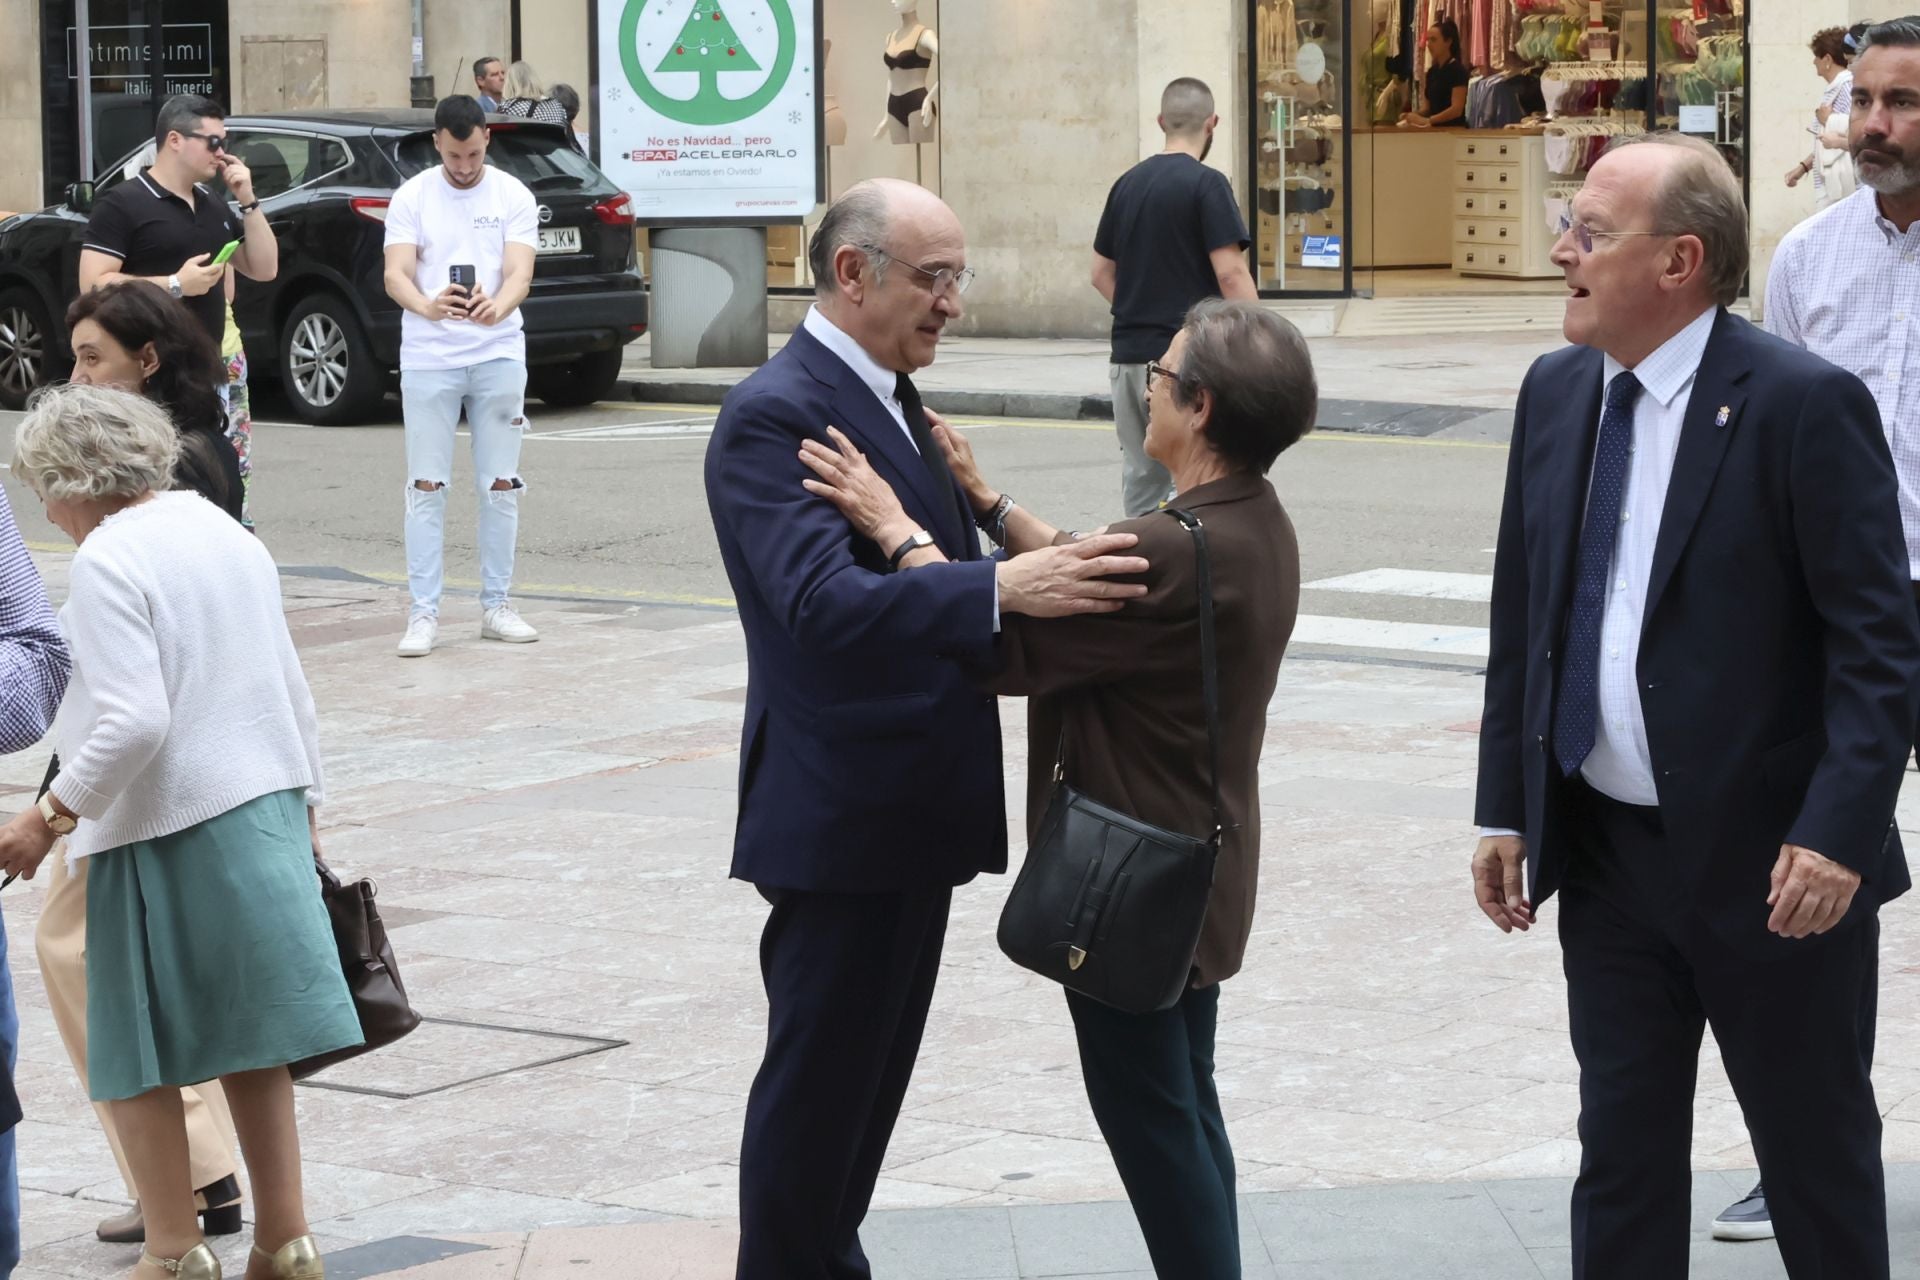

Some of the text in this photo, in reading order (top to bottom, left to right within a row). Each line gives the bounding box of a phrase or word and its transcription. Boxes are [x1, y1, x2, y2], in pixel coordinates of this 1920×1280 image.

[166, 80, 213, 96] lingerie
[647, 137, 664, 147] No
[667, 139, 680, 147] es
[744, 136, 772, 148] pero
[656, 167, 763, 179] ¡Ya estamos en Oviedo!
[474, 216, 500, 225] HOLA
[551, 231, 576, 248] JKM
